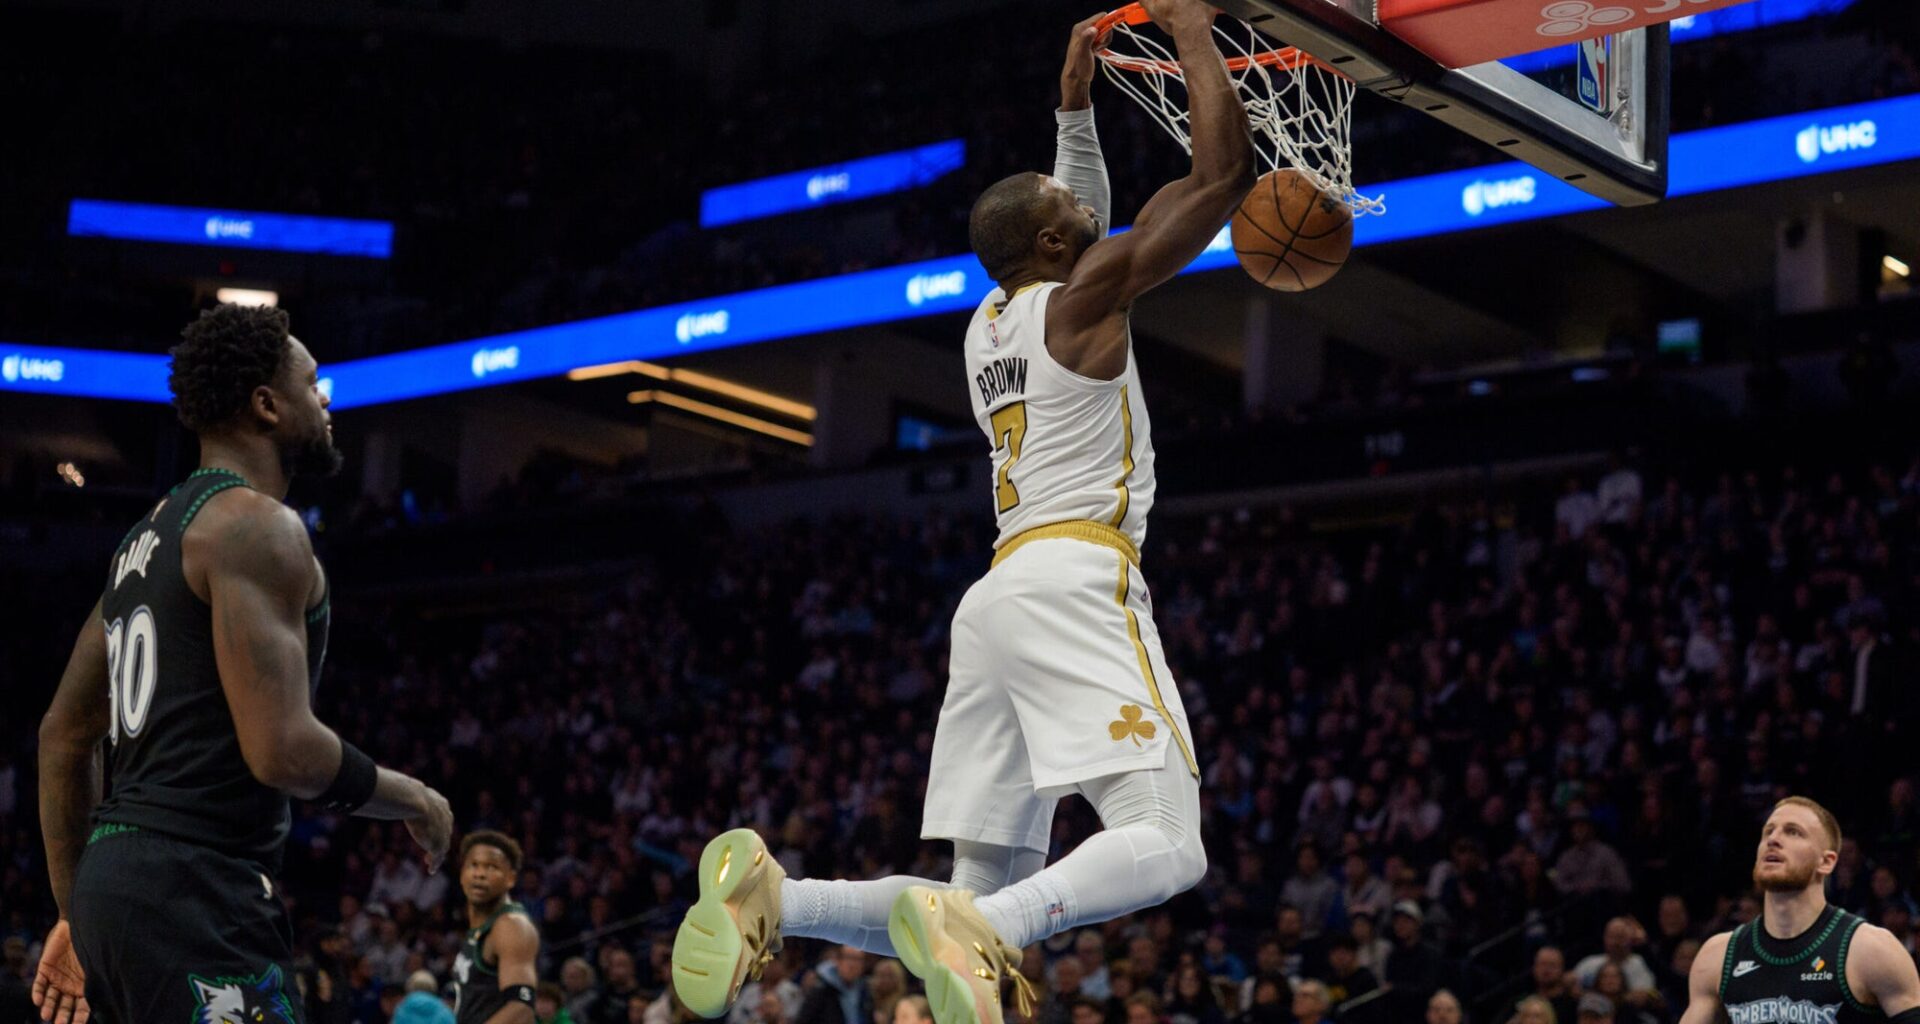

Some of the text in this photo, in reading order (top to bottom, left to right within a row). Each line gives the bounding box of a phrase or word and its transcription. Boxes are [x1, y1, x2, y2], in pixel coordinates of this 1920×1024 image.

[1581, 76, 1596, 101] NBA
[1821, 121, 1875, 152] UHC
[1483, 177, 1534, 208] UHC
[976, 357, 1028, 408] BROWN
[990, 400, 1028, 514] 7
[1800, 971, 1834, 981] sezzle
